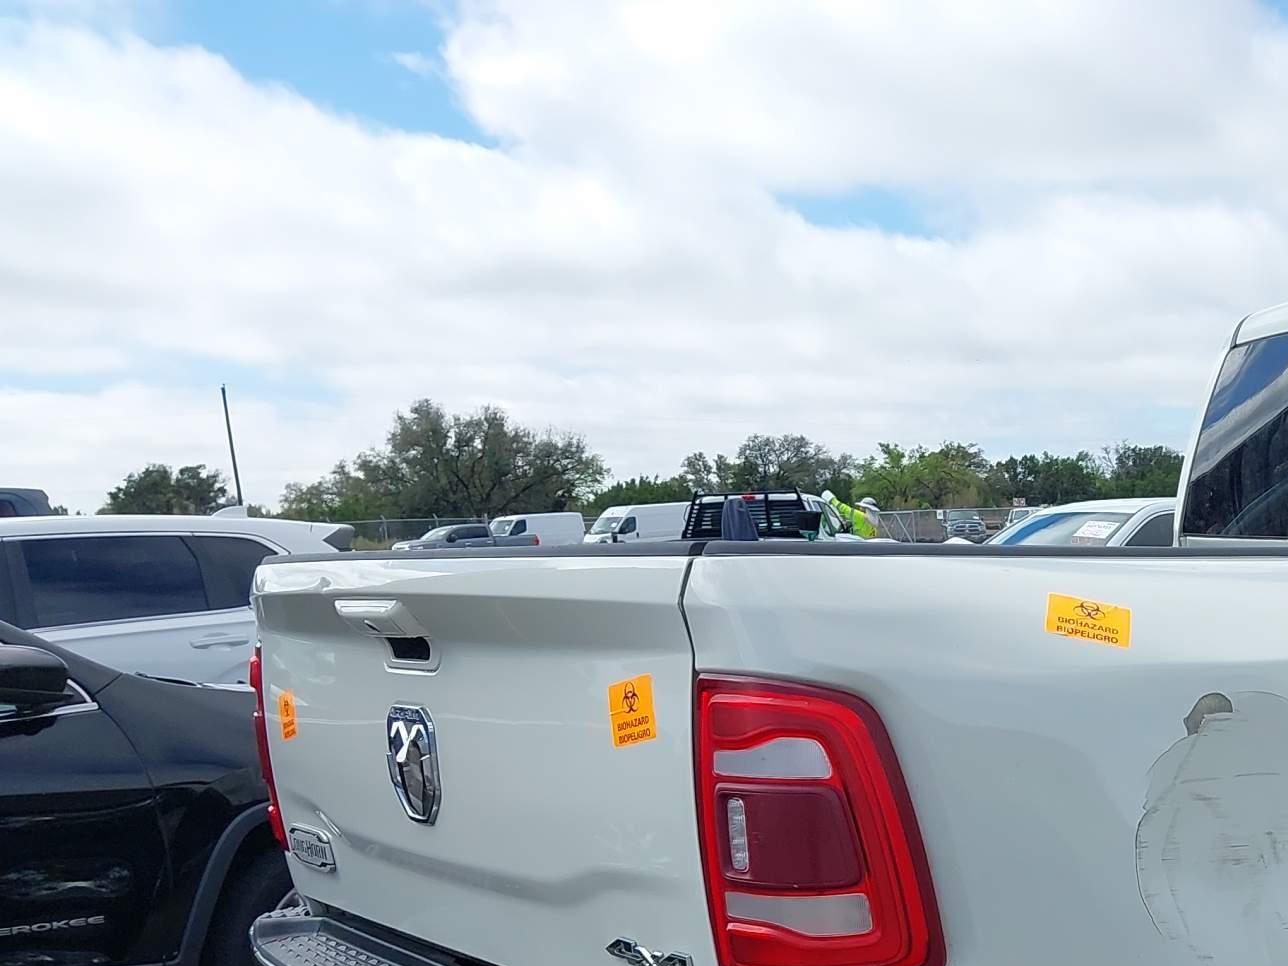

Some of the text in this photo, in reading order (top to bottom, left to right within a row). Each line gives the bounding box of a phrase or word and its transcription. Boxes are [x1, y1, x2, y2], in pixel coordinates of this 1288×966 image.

[1056, 625, 1119, 644] BIOPELIGRO
[1057, 616, 1119, 635] BIOHAZARD
[617, 715, 649, 732] BIOHAZARD
[618, 728, 651, 744] BIOPELIGRO
